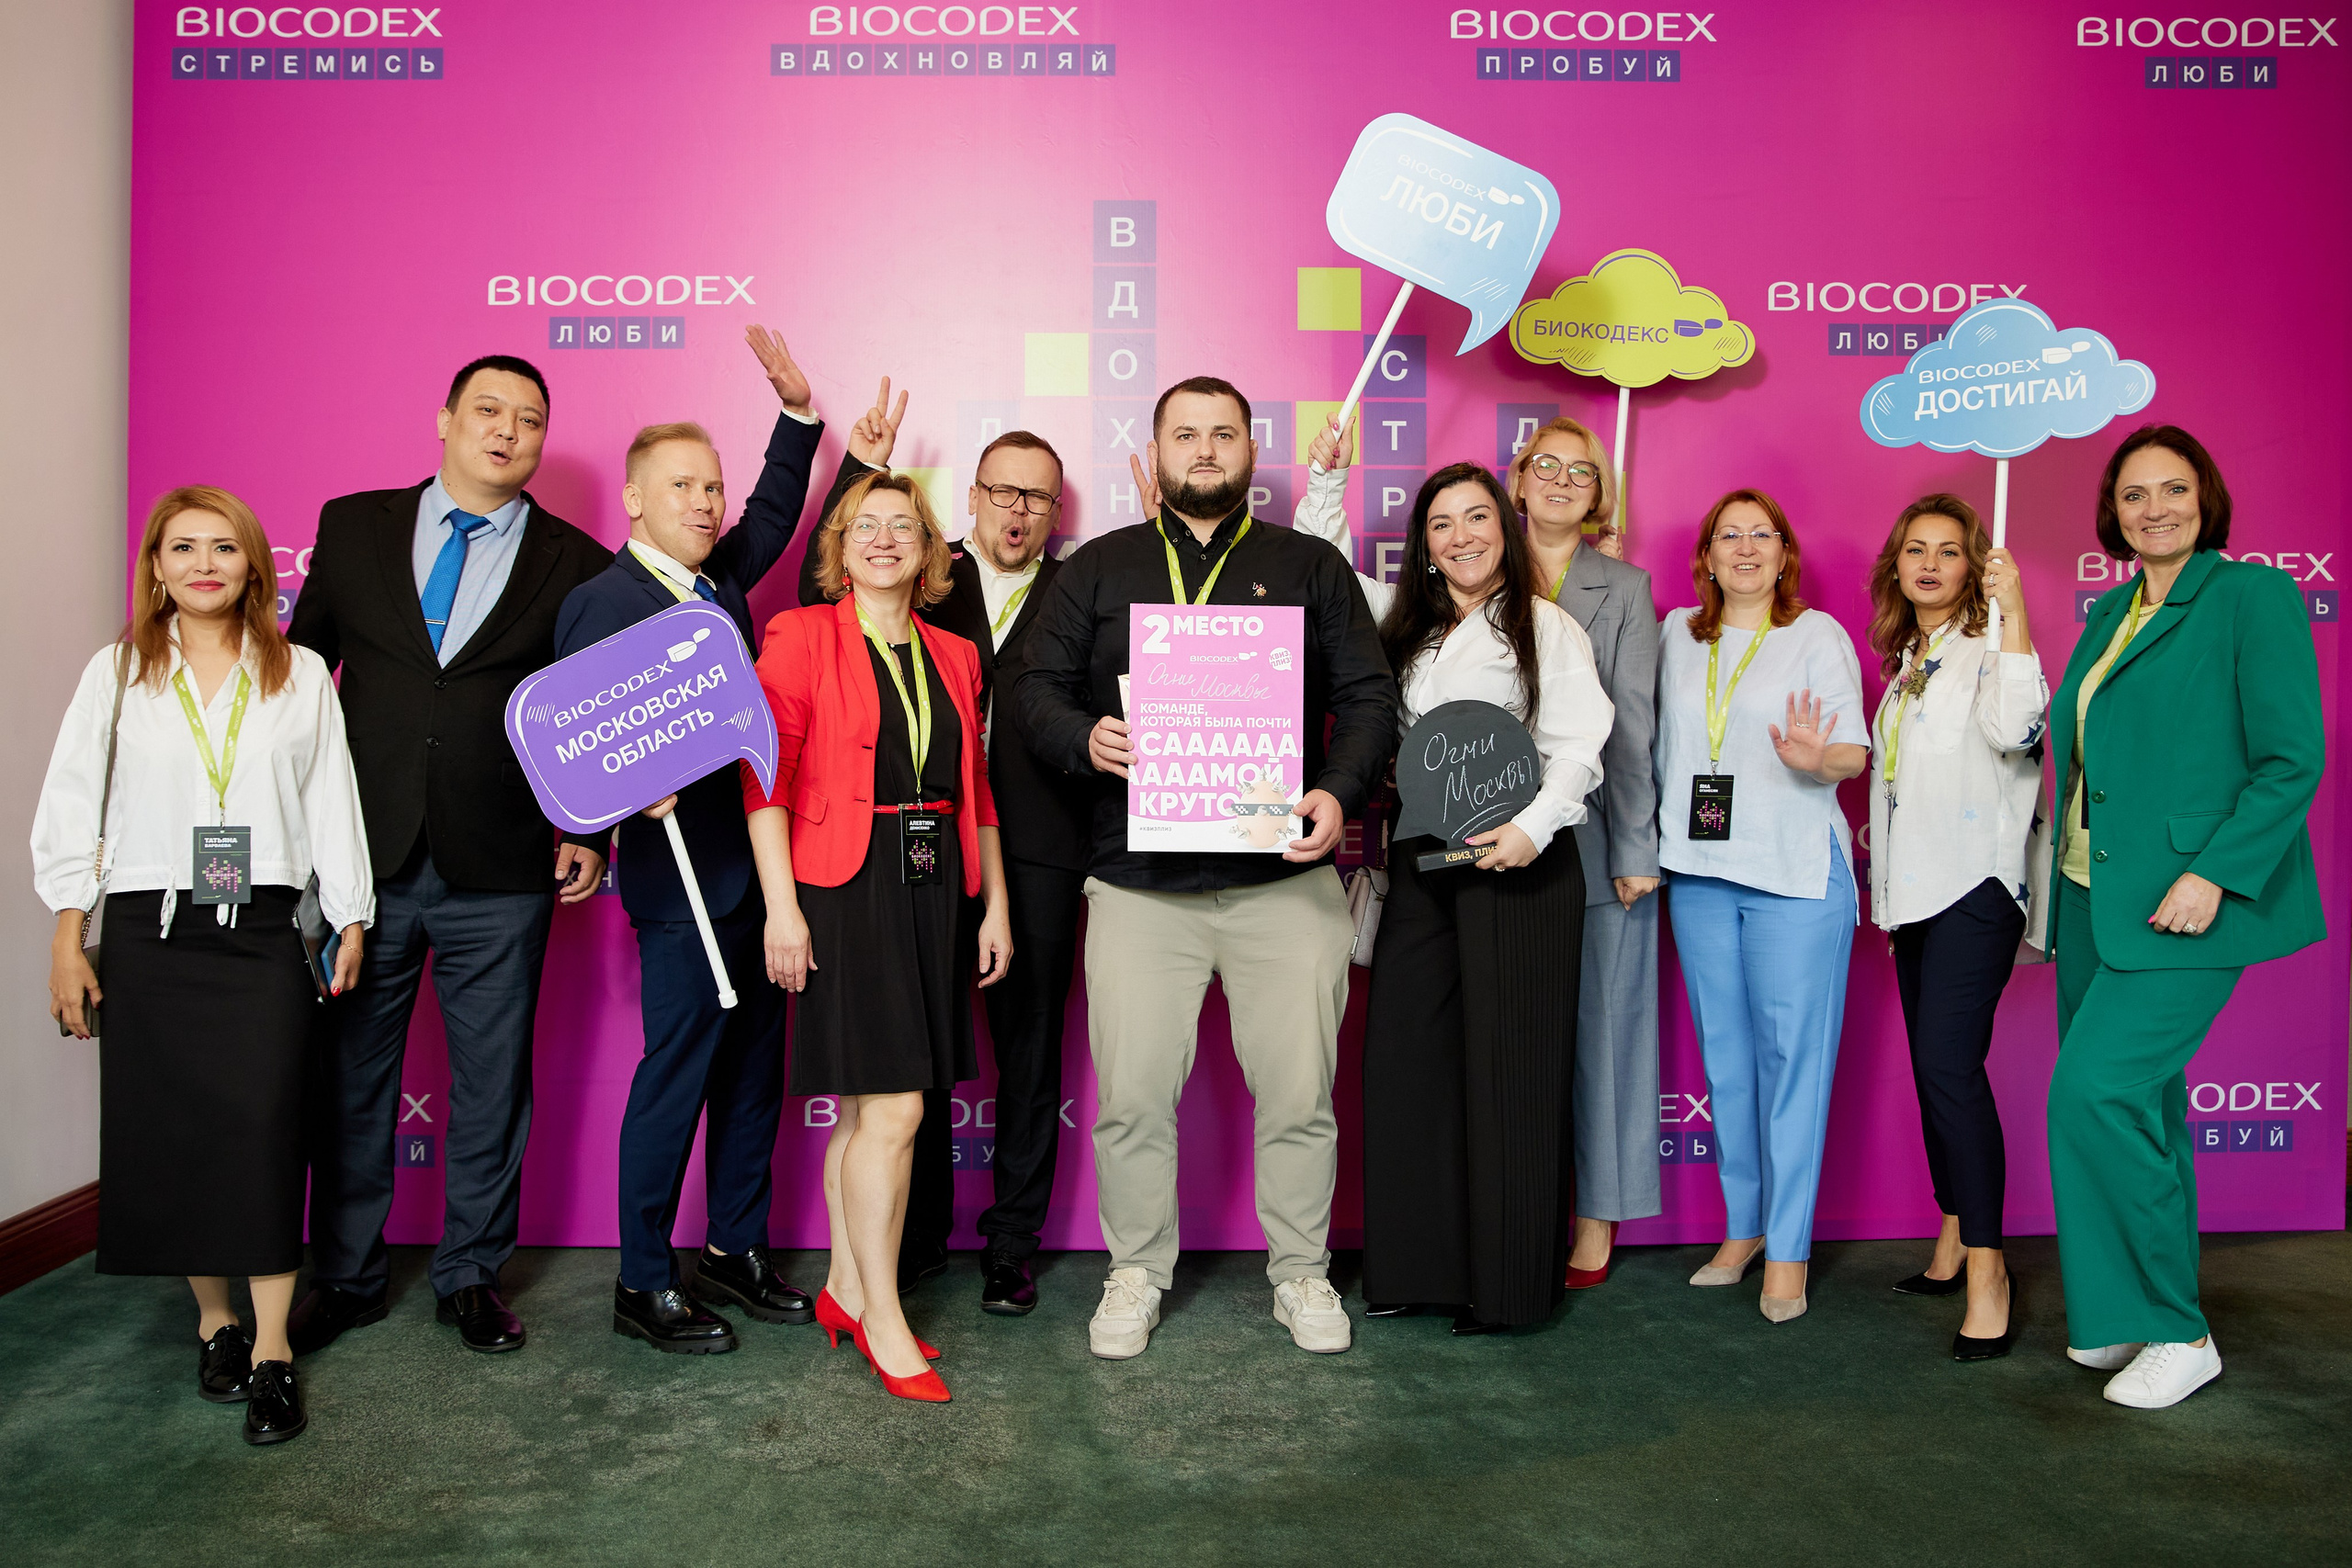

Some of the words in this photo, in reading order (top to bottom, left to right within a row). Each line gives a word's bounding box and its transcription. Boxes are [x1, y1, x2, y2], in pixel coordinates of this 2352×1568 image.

[175, 7, 443, 38] BIOCODEX
[809, 6, 1080, 37] BIOCODEX
[1451, 9, 1717, 42] BIOCODEX
[2076, 17, 2338, 48] BIOCODEX
[178, 53, 437, 75] СТРЕМИСЬ
[777, 49, 1110, 73] ВДОХНОВЛЯЙ
[1483, 54, 1673, 79] ПРОБУЙ
[2150, 63, 2270, 85] ЛЮБИ
[1397, 153, 1488, 202] BIOCODEX
[1379, 174, 1506, 251] ЛЮБИ
[487, 275, 756, 306] BIOCODEX
[555, 322, 679, 344] ЛЮБИ
[1532, 318, 1669, 344] БИОКОДЕКС
[1836, 331, 1943, 350] ЛЮБ
[1917, 357, 2041, 384] BIOCODEX
[1914, 370, 2087, 421] ДОСТИГАЙ
[1141, 614, 1170, 654] 2
[1173, 615, 1264, 637] МЕСТО
[1190, 655, 1238, 663] BIOCODEX
[553, 660, 673, 728] BIOCODEX
[555, 663, 728, 764] МОСКОВСКАЯ
[1140, 703, 1208, 716] КОМАНДЕ,
[1140, 716, 1201, 728] КОТОРАЯ
[1204, 716, 1243, 728] БЫЛА
[1246, 717, 1292, 728] ПОЧТИ
[602, 708, 715, 773] ОБЛАСТЬ
[1139, 731, 1303, 758] САААААА
[1138, 792, 1241, 817] КРУТО
[1445, 850, 1473, 863] КВИЗ,
[1475, 845, 1498, 858] ПЛИ
